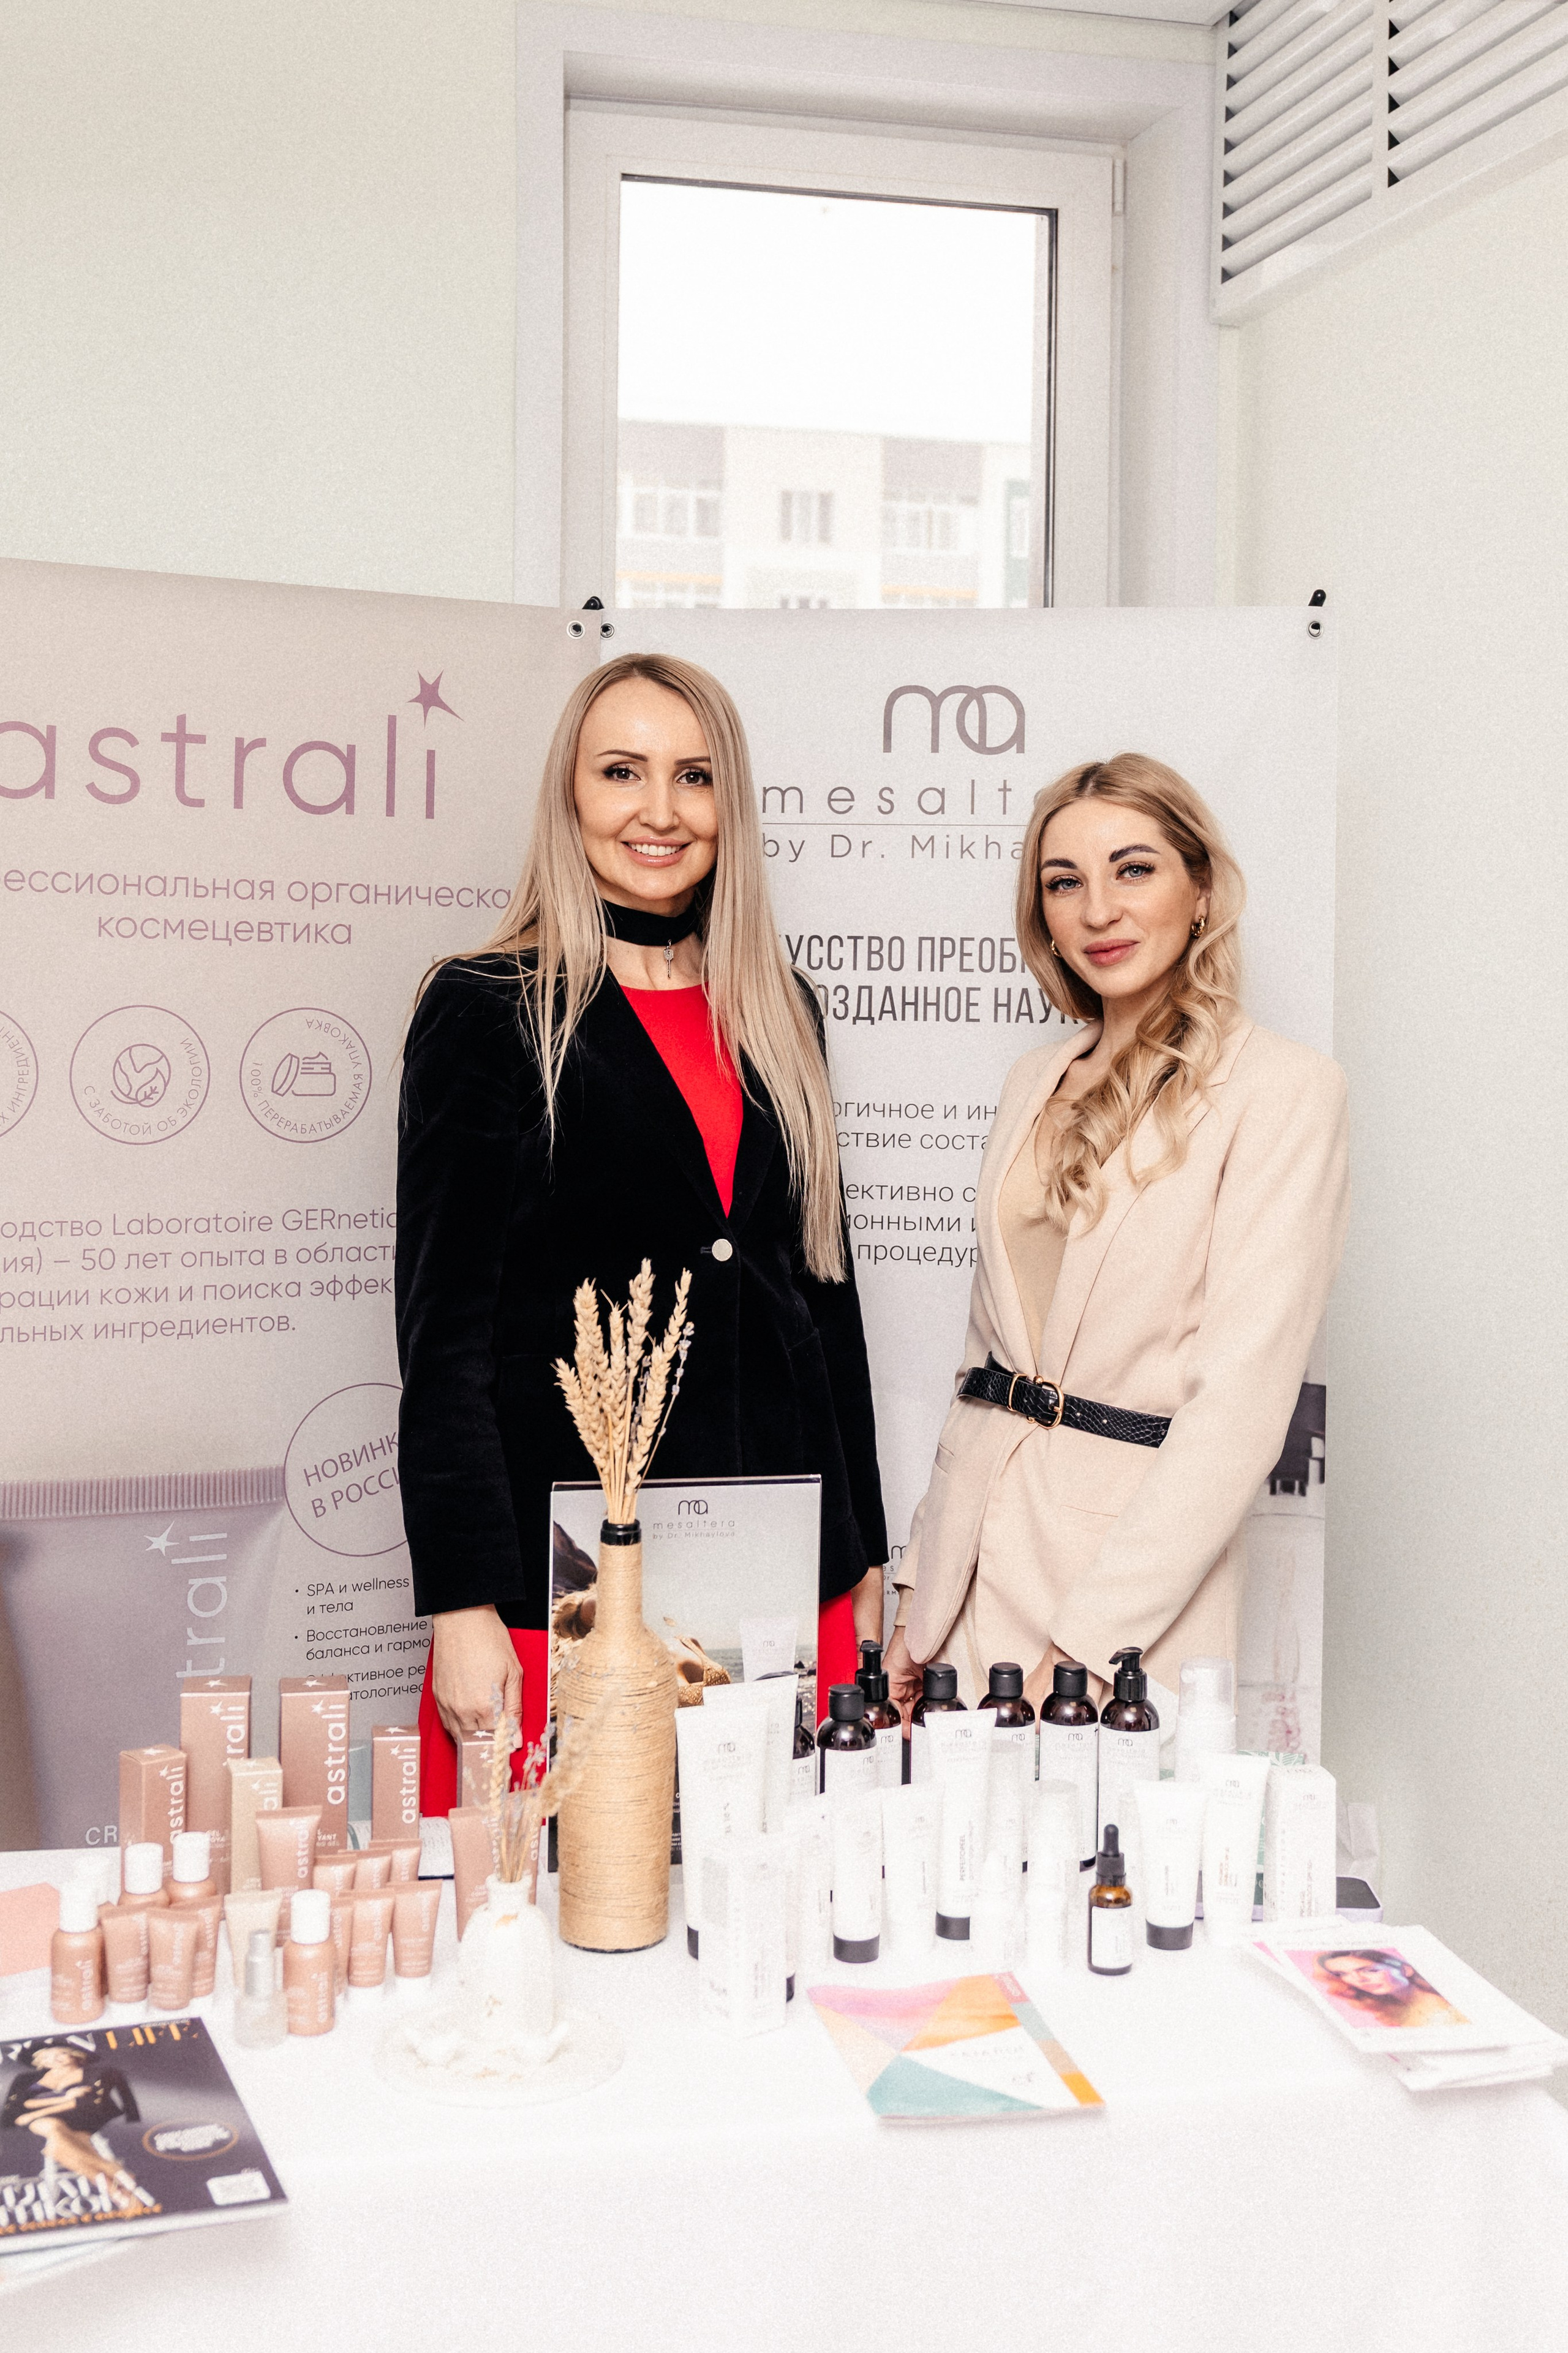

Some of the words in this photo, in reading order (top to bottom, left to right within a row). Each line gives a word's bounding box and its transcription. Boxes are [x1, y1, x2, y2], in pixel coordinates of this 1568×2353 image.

[0, 670, 453, 820] astrali
[762, 779, 1036, 815] mesalt
[762, 833, 805, 863] by
[831, 834, 886, 858] Dr.
[4, 869, 274, 901] ессиональная
[287, 880, 511, 910] органическа
[98, 915, 353, 946] космецевтика
[780, 934, 905, 972] УССТВО
[993, 987, 1078, 1025] НАУ
[306, 1019, 361, 1069] УПАКОВКА
[84, 1086, 96, 1096] С
[176, 1038, 202, 1117] ЭКОЛОГИИ
[251, 1062, 263, 1098] 100%
[89, 1099, 152, 1135] ЗАБОТОЙ
[258, 1074, 363, 1134] ПЕРЕРАБАТЫВАЕМАЯ
[944, 1105, 957, 1119] и
[157, 1116, 177, 1131] ОБ
[838, 1131, 911, 1148] ствие
[846, 1184, 954, 1201] ективно
[1, 1219, 102, 1242] одство
[113, 1210, 273, 1236] Laboratoire
[4, 1247, 42, 1275] ия)
[81, 1248, 116, 1271] 50
[124, 1251, 172, 1269] лет
[181, 1248, 265, 1267] опыта
[275, 1248, 287, 1265] в
[858, 1244, 978, 1267] процедур
[0, 1288, 89, 1315] рации
[100, 1285, 169, 1305] кожи
[179, 1285, 194, 1302] и
[204, 1278, 301, 1301] поиска
[0, 1323, 84, 1343] льных
[94, 1314, 296, 1343] ингредиентов.
[303, 1432, 398, 1487] НОВИНК
[311, 1498, 326, 1518] В
[653, 1520, 735, 1530] mesaltera
[307, 1582, 334, 1596] SPA
[339, 1584, 347, 1594] и
[351, 1576, 410, 1592] wellness
[307, 1604, 315, 1615] и
[320, 1600, 353, 1613] тела
[307, 1620, 428, 1642] Восстановление
[306, 1645, 369, 1660] баланса
[375, 1644, 382, 1653] и
[387, 1638, 431, 1653] гармо
[318, 1703, 347, 1805] astrali
[394, 1746, 417, 1824] astrali
